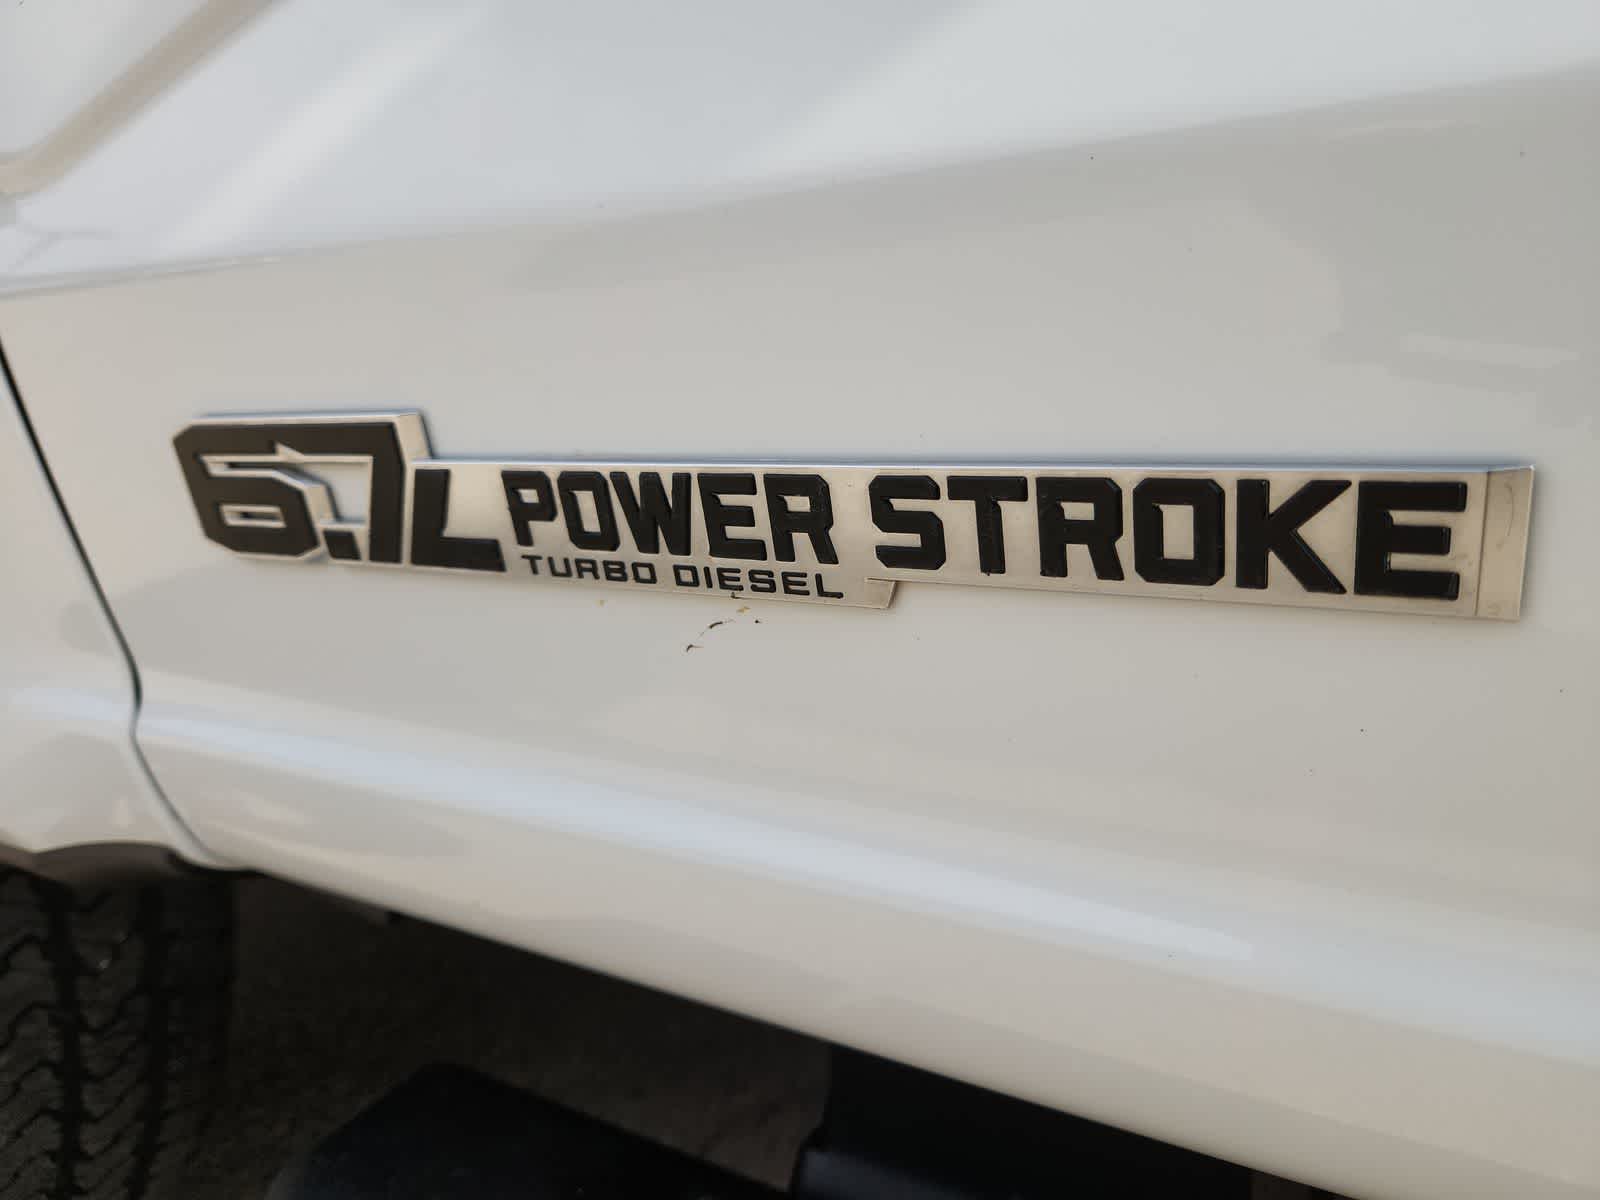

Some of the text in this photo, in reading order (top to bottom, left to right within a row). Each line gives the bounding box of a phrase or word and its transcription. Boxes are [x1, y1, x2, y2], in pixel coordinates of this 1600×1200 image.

[172, 422, 1468, 600] 6.7L POWER STROKE
[521, 555, 844, 599] TURBO DIESEL
